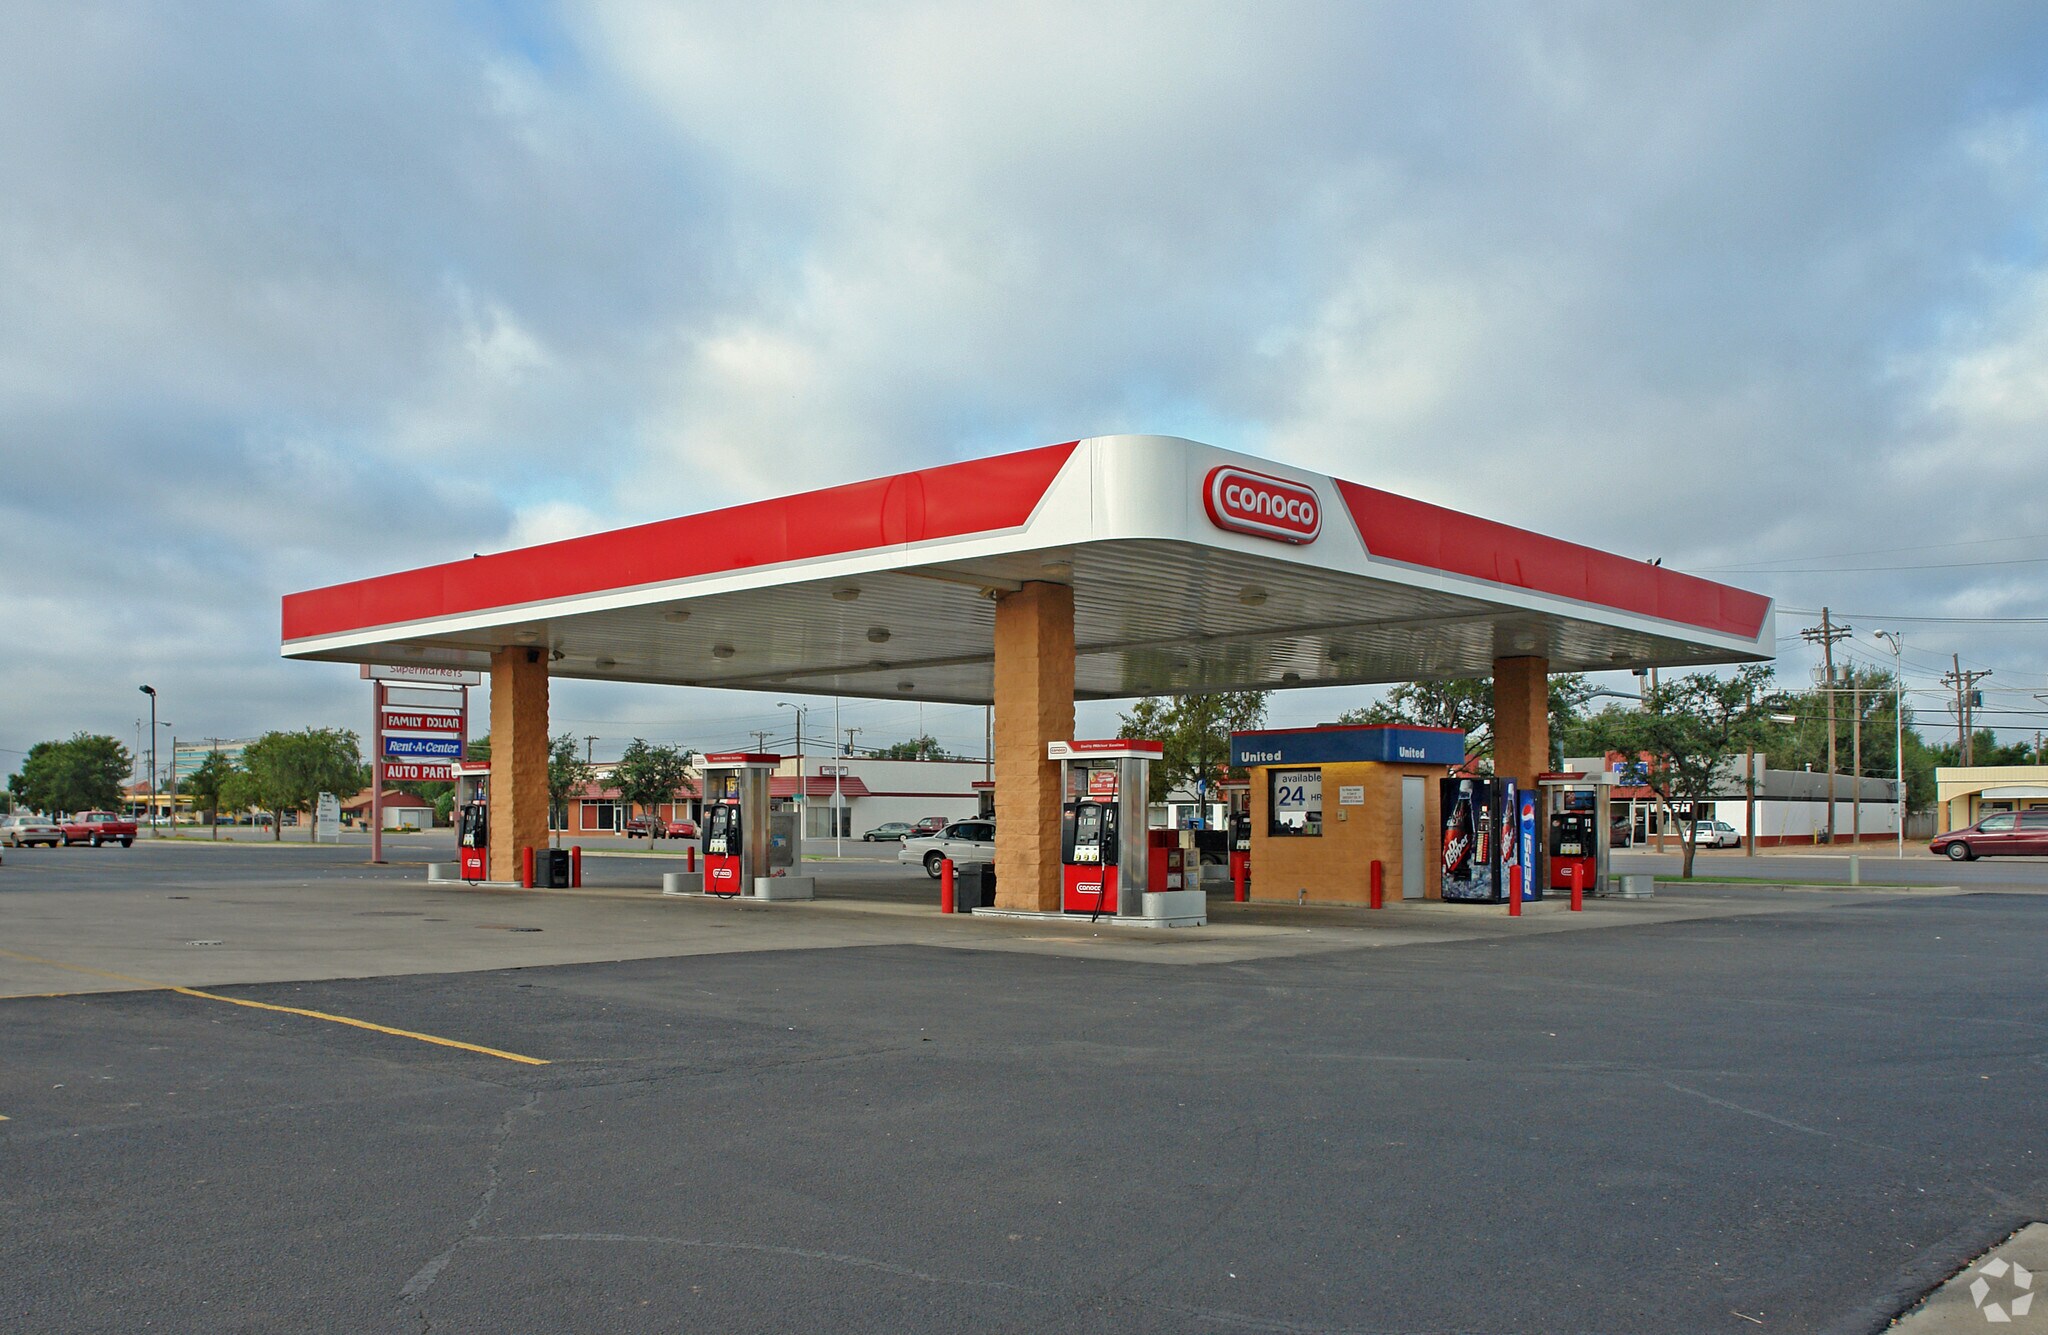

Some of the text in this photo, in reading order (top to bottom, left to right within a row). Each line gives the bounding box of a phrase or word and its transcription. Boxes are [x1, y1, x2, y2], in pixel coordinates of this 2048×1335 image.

[388, 715, 459, 729] FAMILY DOLLAR
[1241, 750, 1282, 762] United
[1399, 746, 1425, 759] United
[387, 765, 418, 778] AUTO
[1282, 774, 1322, 783] available
[1278, 785, 1322, 806] 24 HR
[731, 809, 737, 820] 3
[1584, 818, 1591, 828] 11
[1448, 837, 1458, 852] Dr
[1445, 834, 1468, 869] Pepper
[1524, 833, 1532, 895] PEPSI
